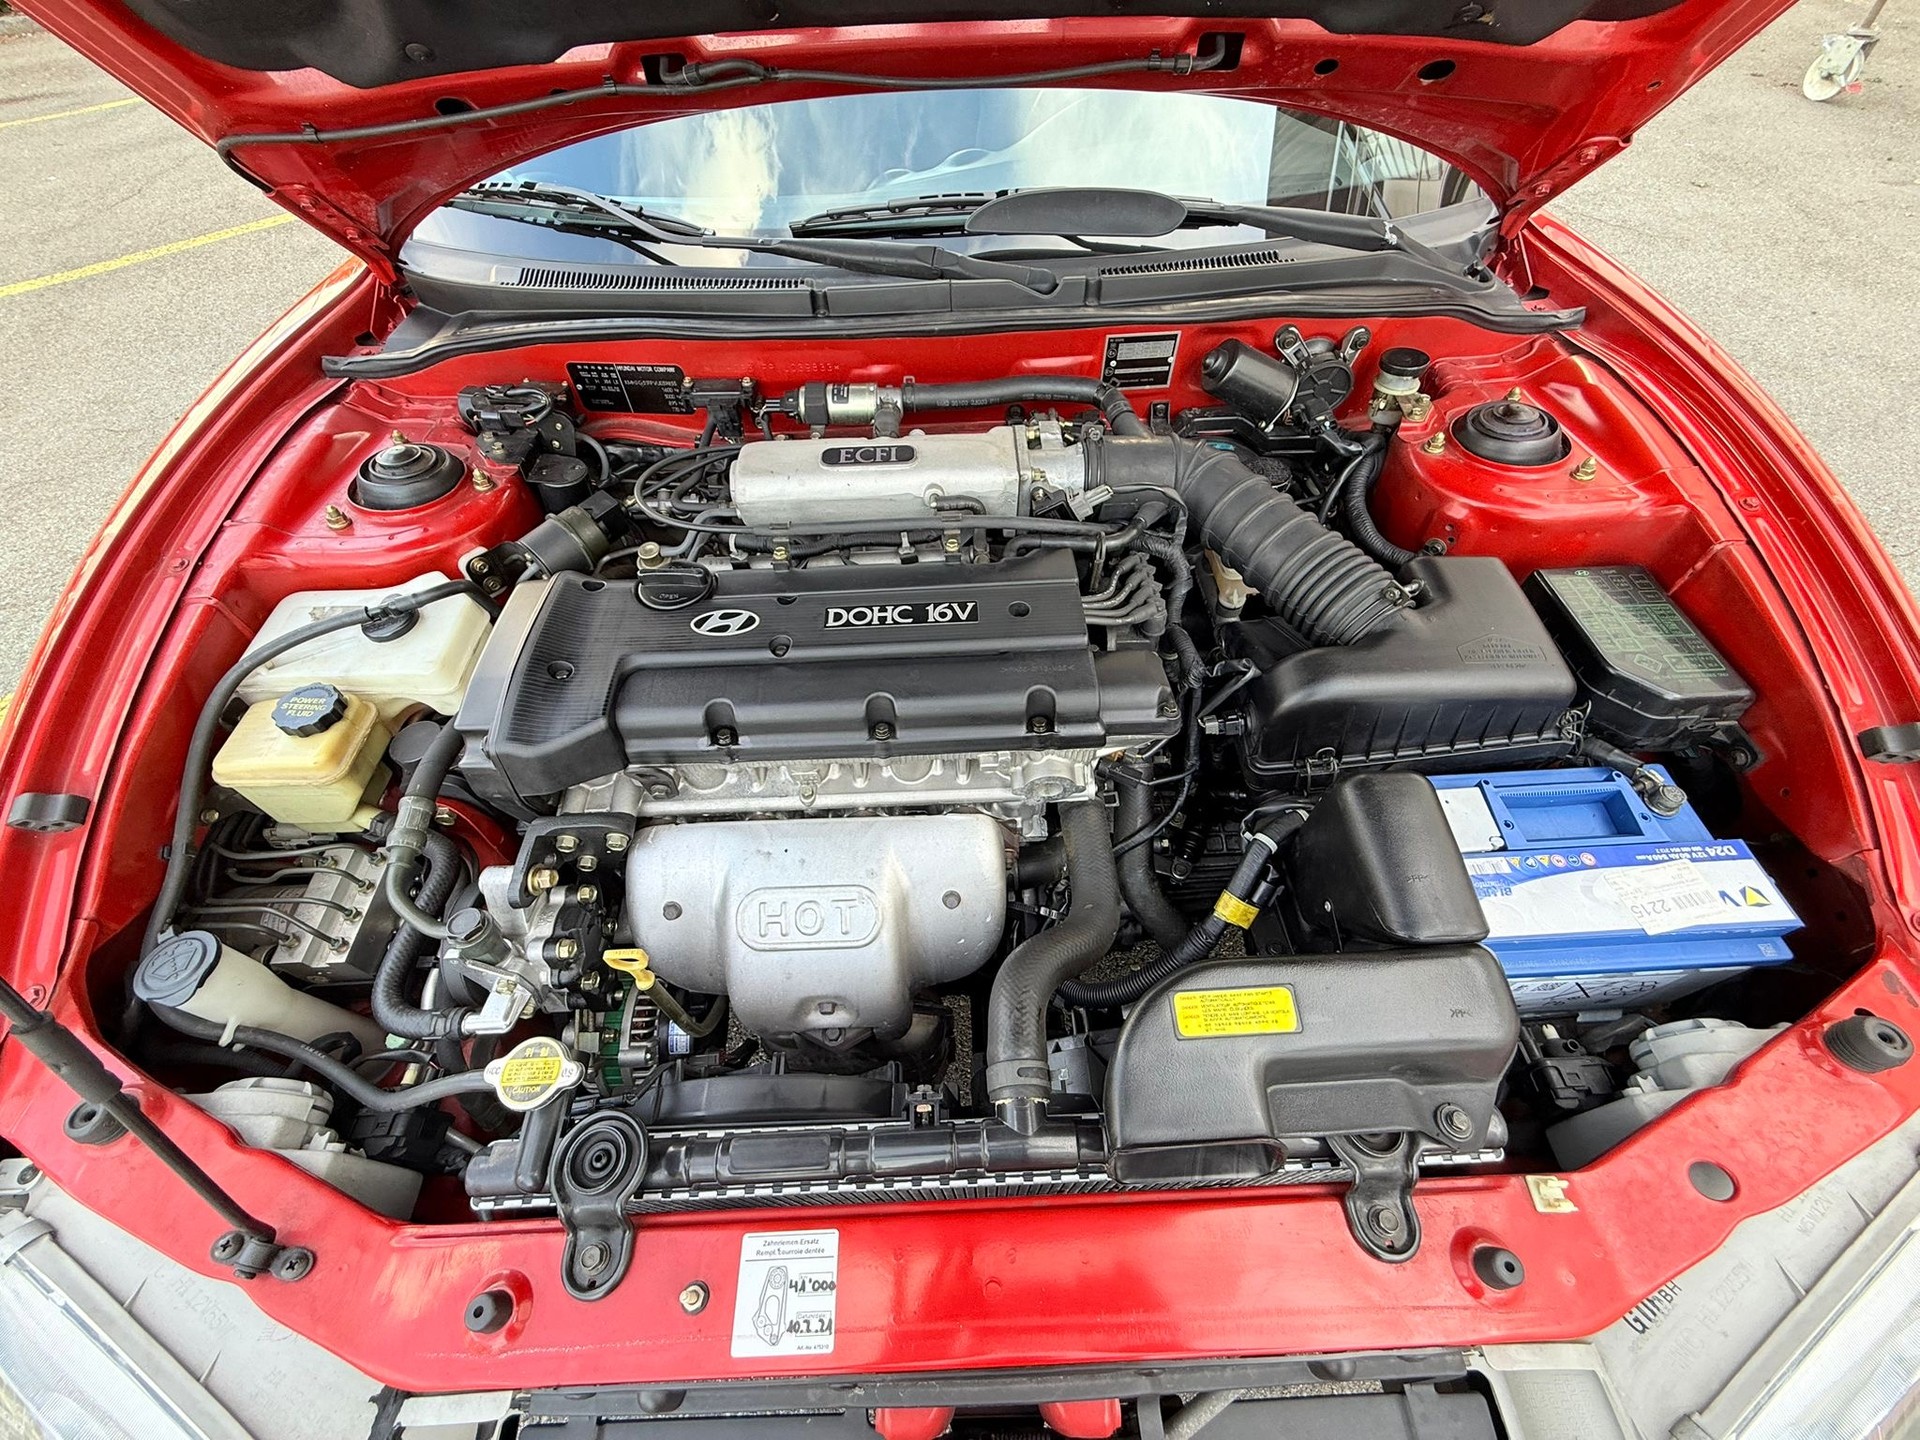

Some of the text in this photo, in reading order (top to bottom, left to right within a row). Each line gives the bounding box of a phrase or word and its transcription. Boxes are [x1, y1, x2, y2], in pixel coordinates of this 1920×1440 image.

[838, 447, 898, 463] ECFI
[825, 602, 975, 627] DOHC 16V
[280, 702, 328, 711] STEERING
[289, 696, 327, 704] POWER
[285, 709, 315, 717] FLUID
[1705, 845, 1738, 857] D24
[1630, 899, 1672, 919] 2215
[758, 898, 858, 938] HOT
[511, 1086, 542, 1095] CAUTION
[789, 1278, 836, 1293] 41'000
